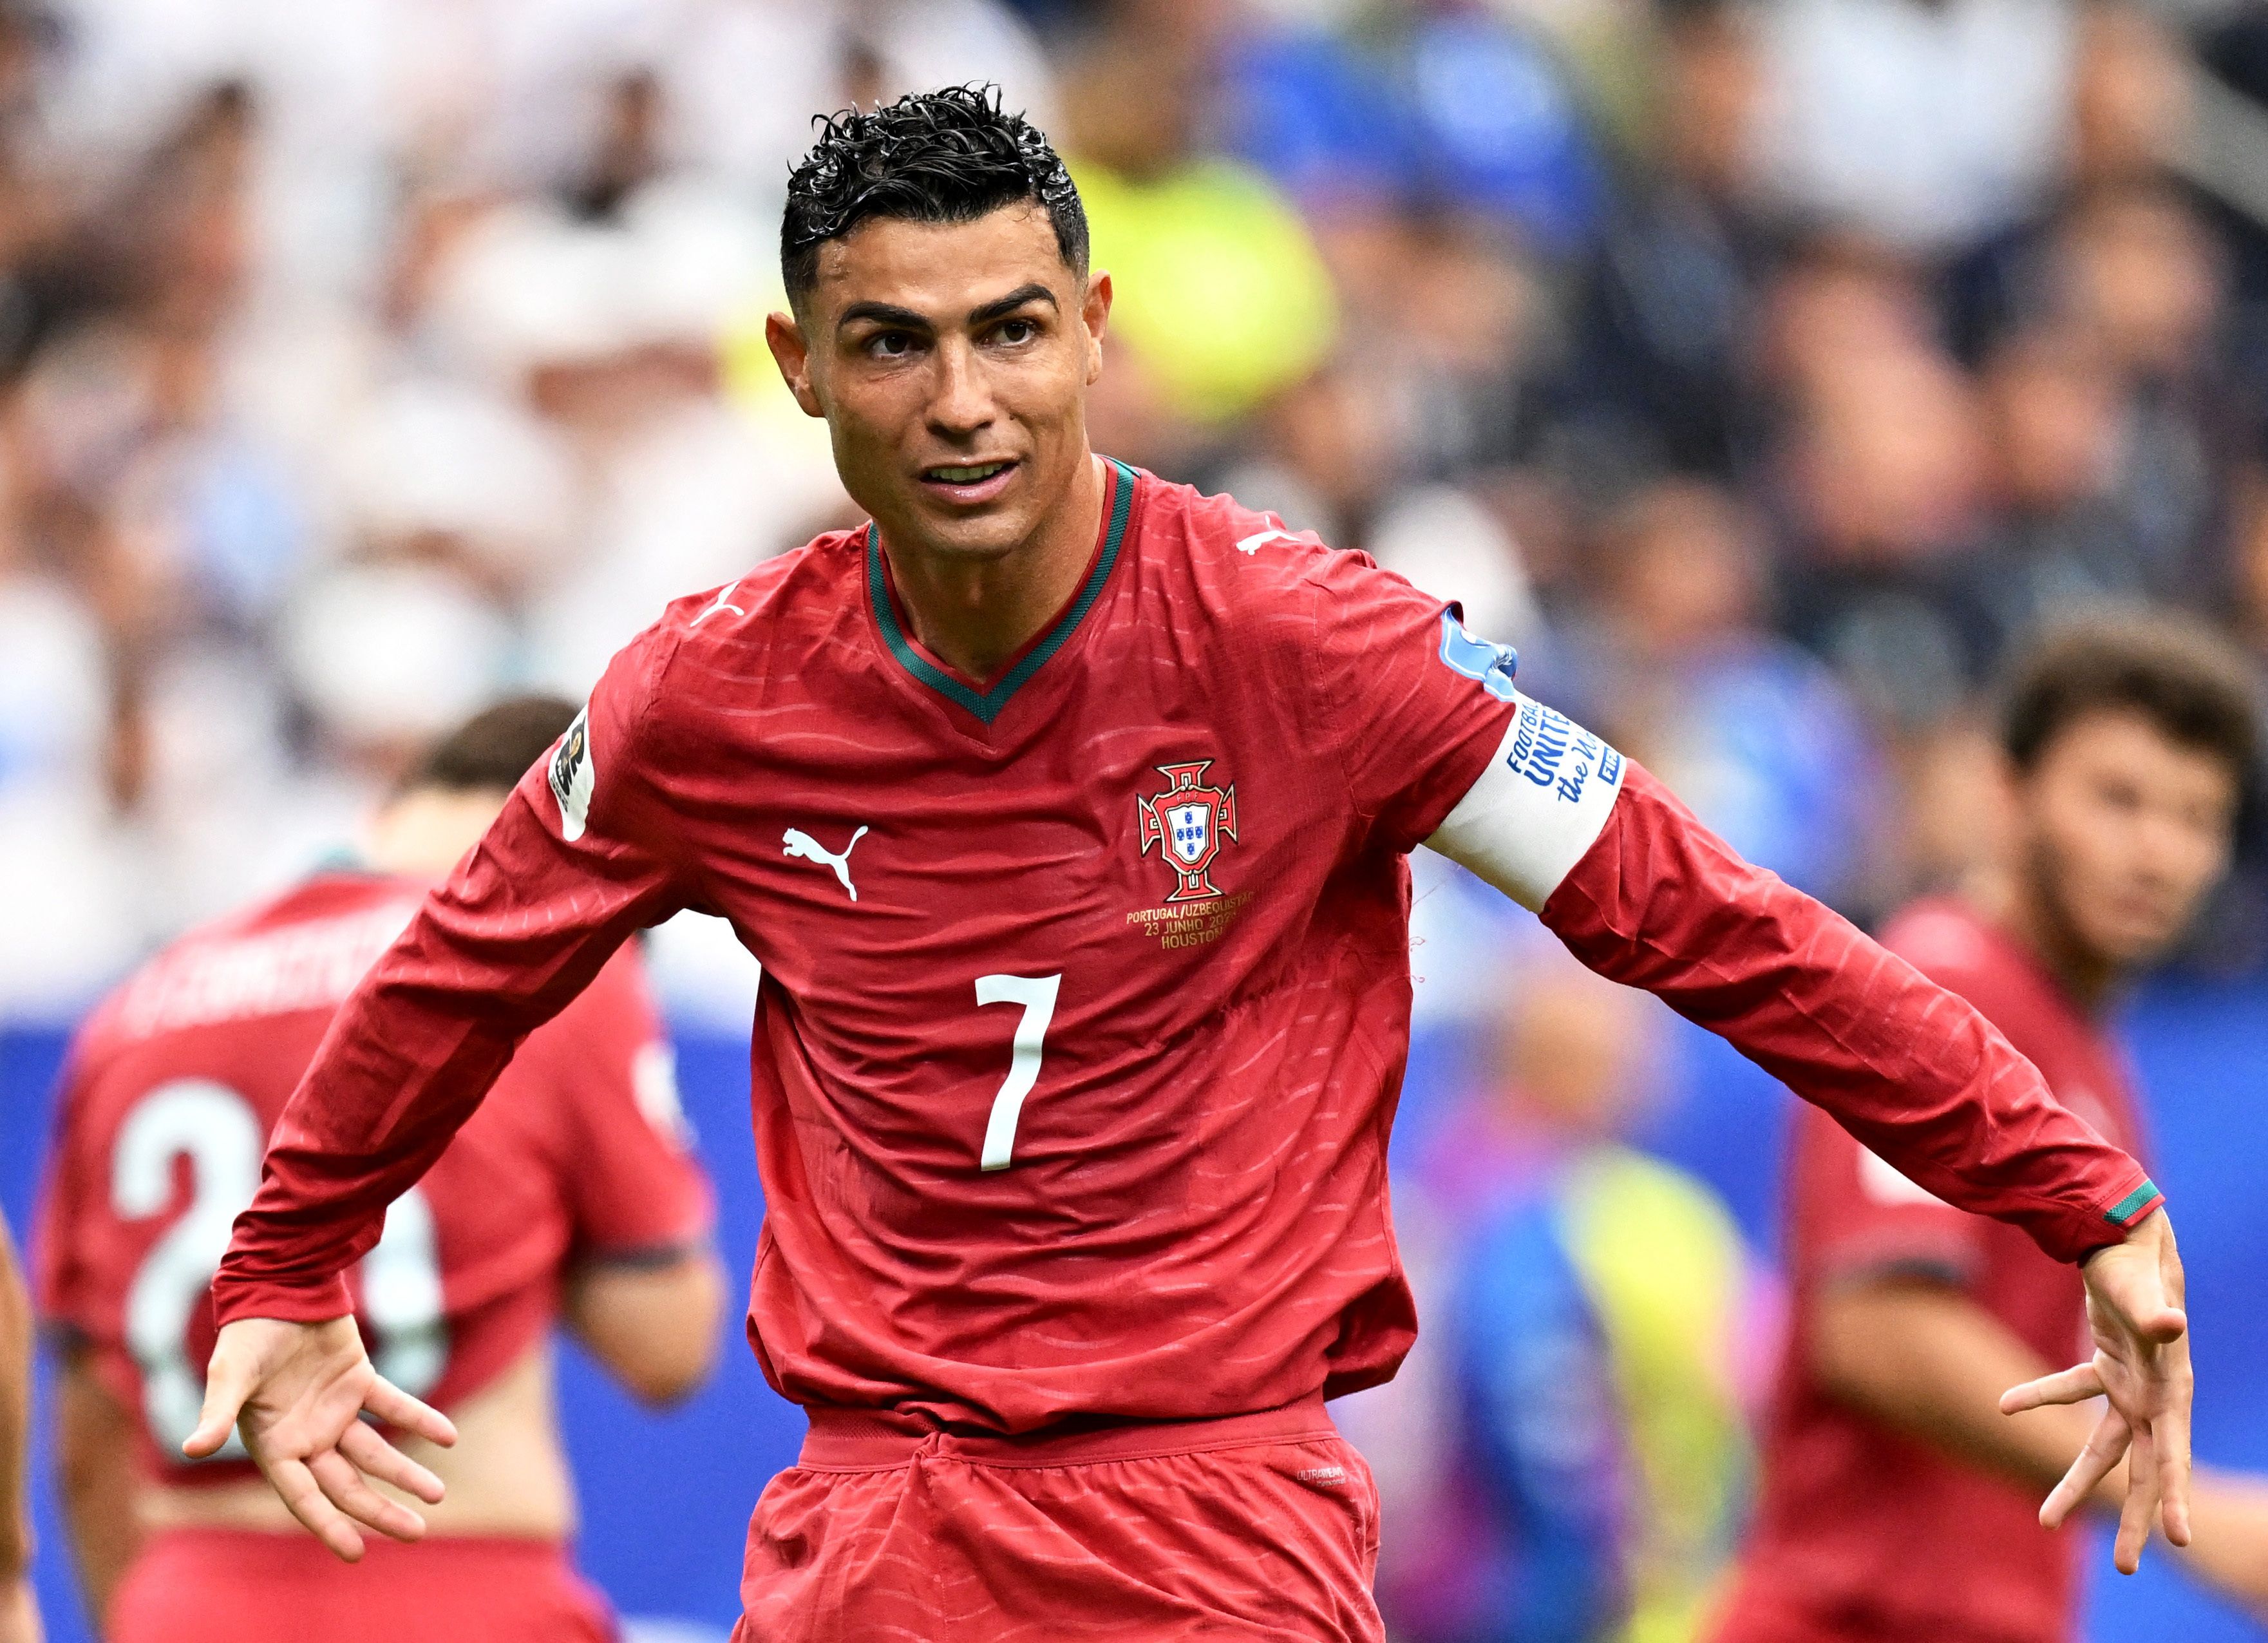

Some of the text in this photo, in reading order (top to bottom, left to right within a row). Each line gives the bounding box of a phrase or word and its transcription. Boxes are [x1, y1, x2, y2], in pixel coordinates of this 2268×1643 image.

[1507, 702, 1539, 774] FOOTBAL
[1524, 710, 1570, 786] UNITE
[1557, 761, 1588, 803] the
[1144, 911, 1236, 936] 23 JUNHO 202
[974, 973, 1062, 1172] 7
